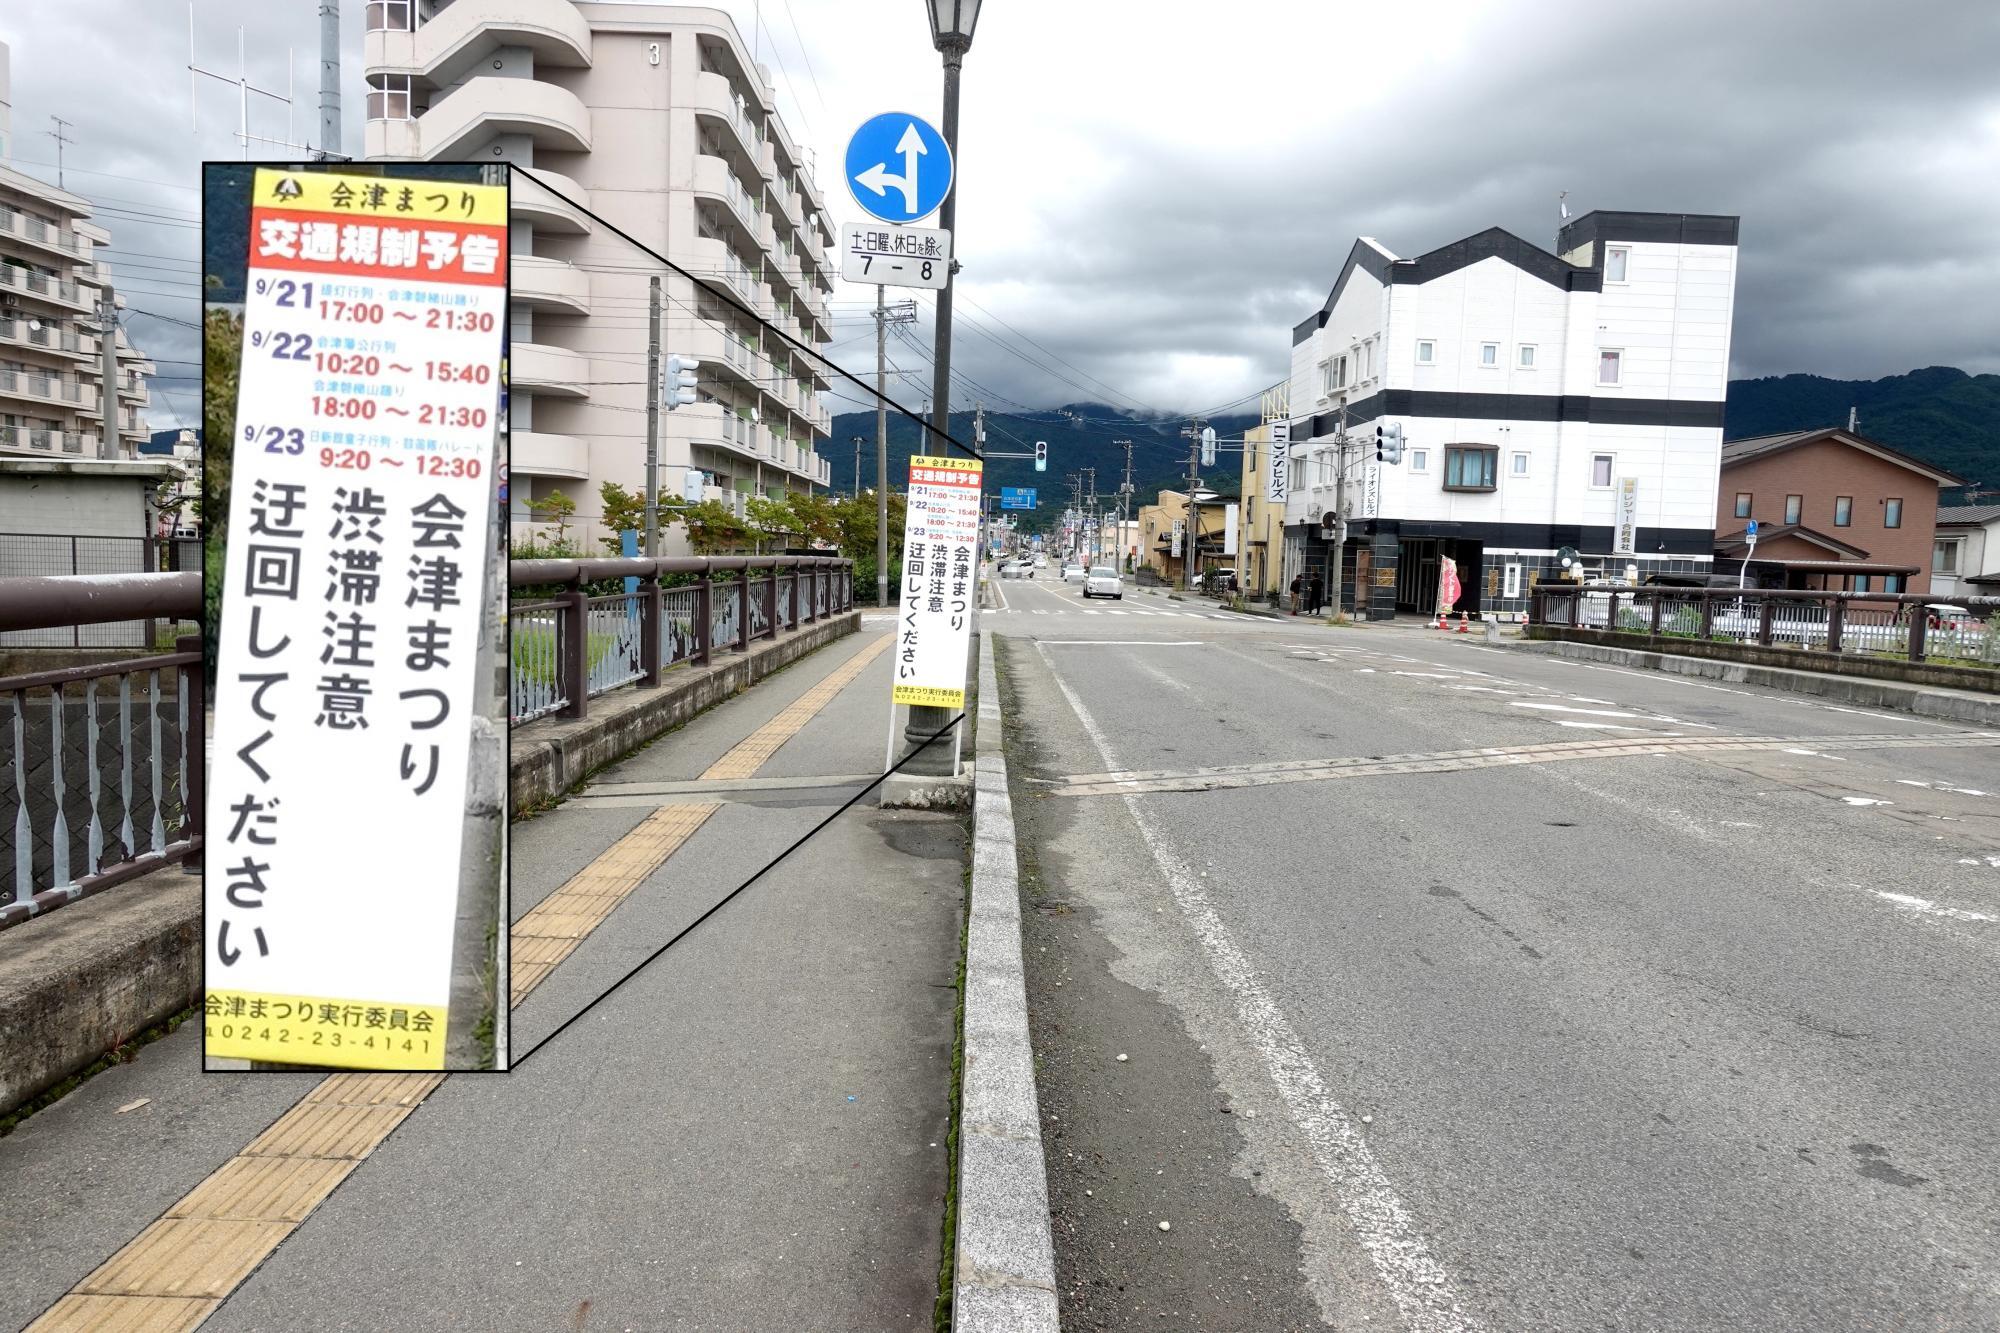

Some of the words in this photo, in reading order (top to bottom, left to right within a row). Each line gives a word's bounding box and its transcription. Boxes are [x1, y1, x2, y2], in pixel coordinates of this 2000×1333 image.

[650, 43, 660, 66] 3
[330, 181, 476, 218] 会津まつり
[259, 218, 500, 274] 交通規制予告
[860, 255, 873, 276] 7
[920, 261, 933, 280] 8
[255, 279, 313, 309] 9/21
[251, 331, 313, 361] 9/22
[244, 425, 304, 456] 9/23
[928, 544, 948, 613] 渋滞注意
[951, 546, 970, 631] 会津まつり
[314, 487, 387, 730] 渋滞注意
[900, 542, 926, 679] 迂回してください
[399, 493, 467, 796] 会津まつり
[217, 478, 307, 967] 迂回してください
[205, 994, 434, 1033] 会津まつり実行委員会
